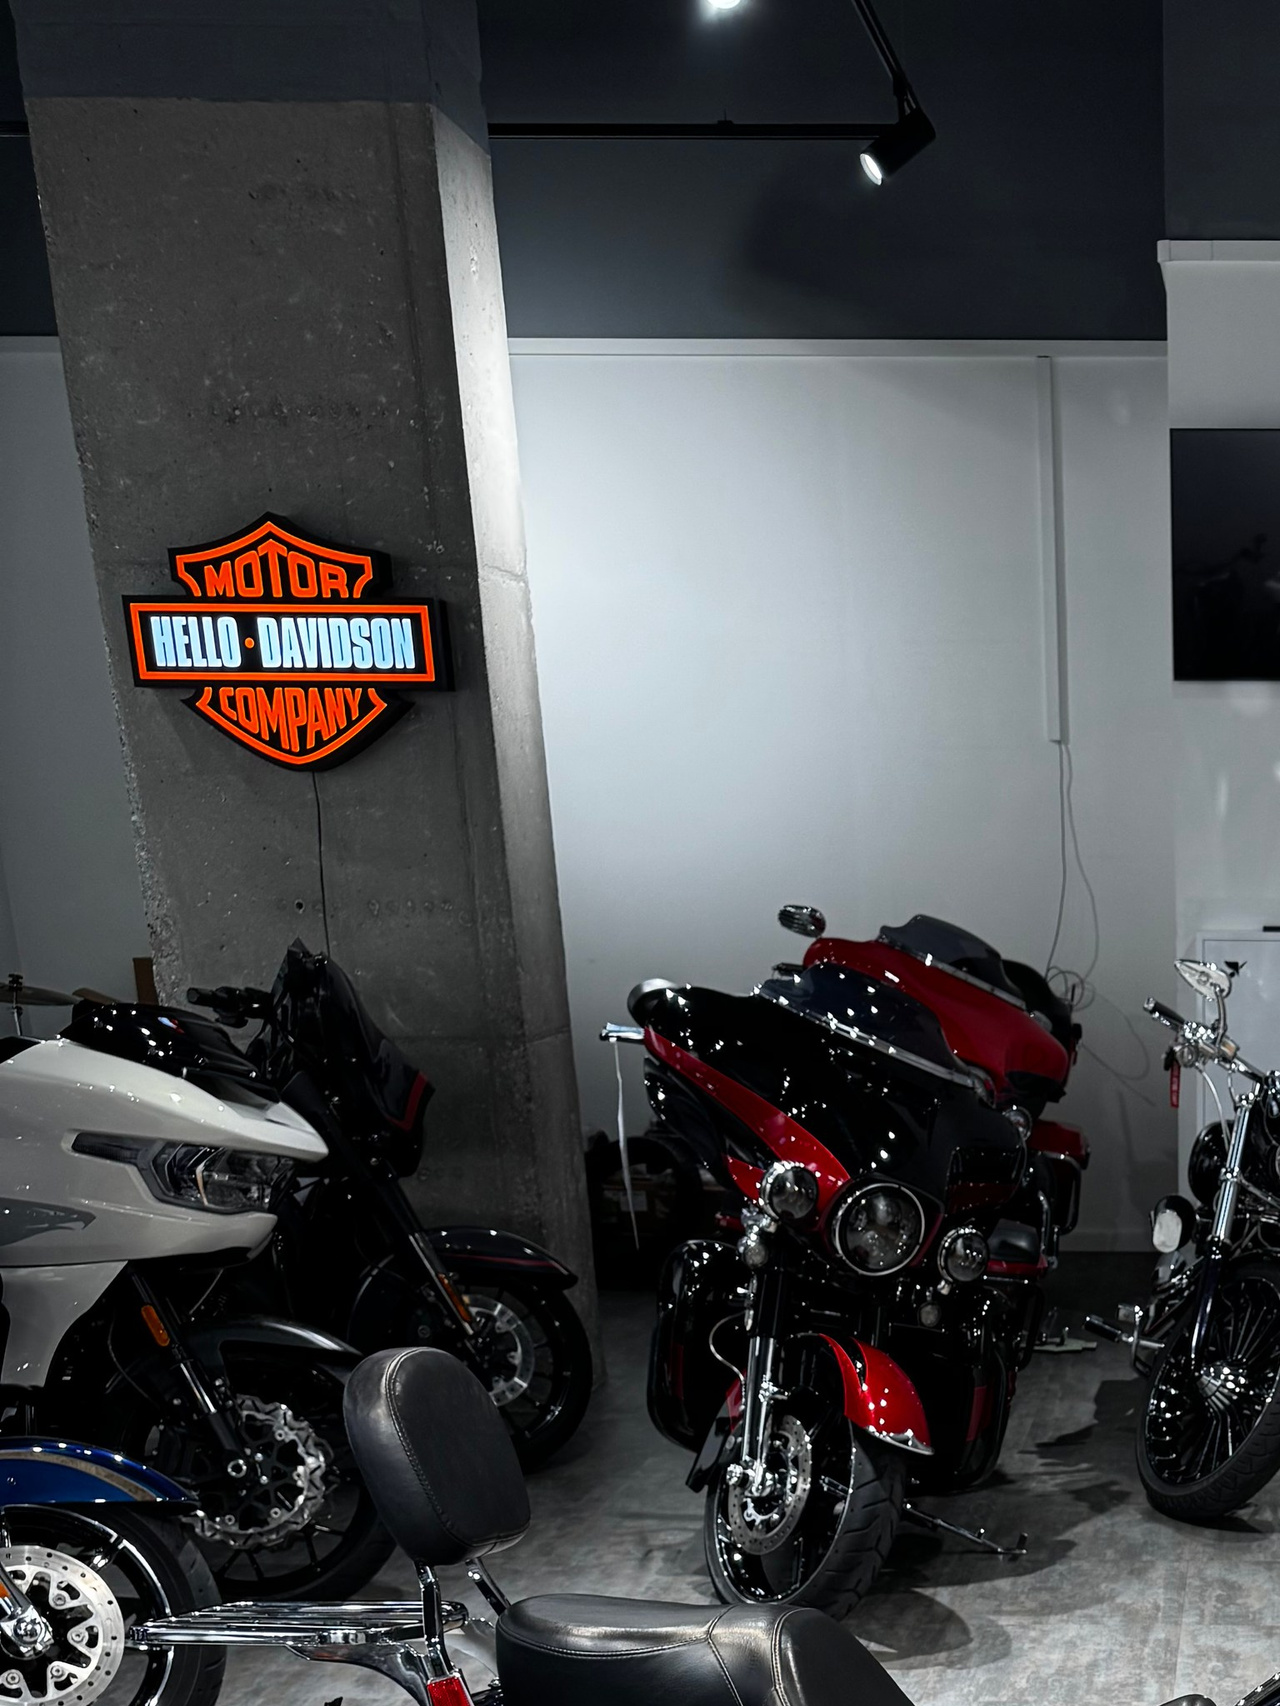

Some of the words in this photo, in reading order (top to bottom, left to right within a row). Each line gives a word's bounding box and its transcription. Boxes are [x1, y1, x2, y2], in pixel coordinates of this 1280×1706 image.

[204, 539, 349, 598] MOTOR
[150, 616, 242, 667] HELLO
[257, 617, 416, 668] DAVIDSON
[219, 687, 363, 752] COMPANY
